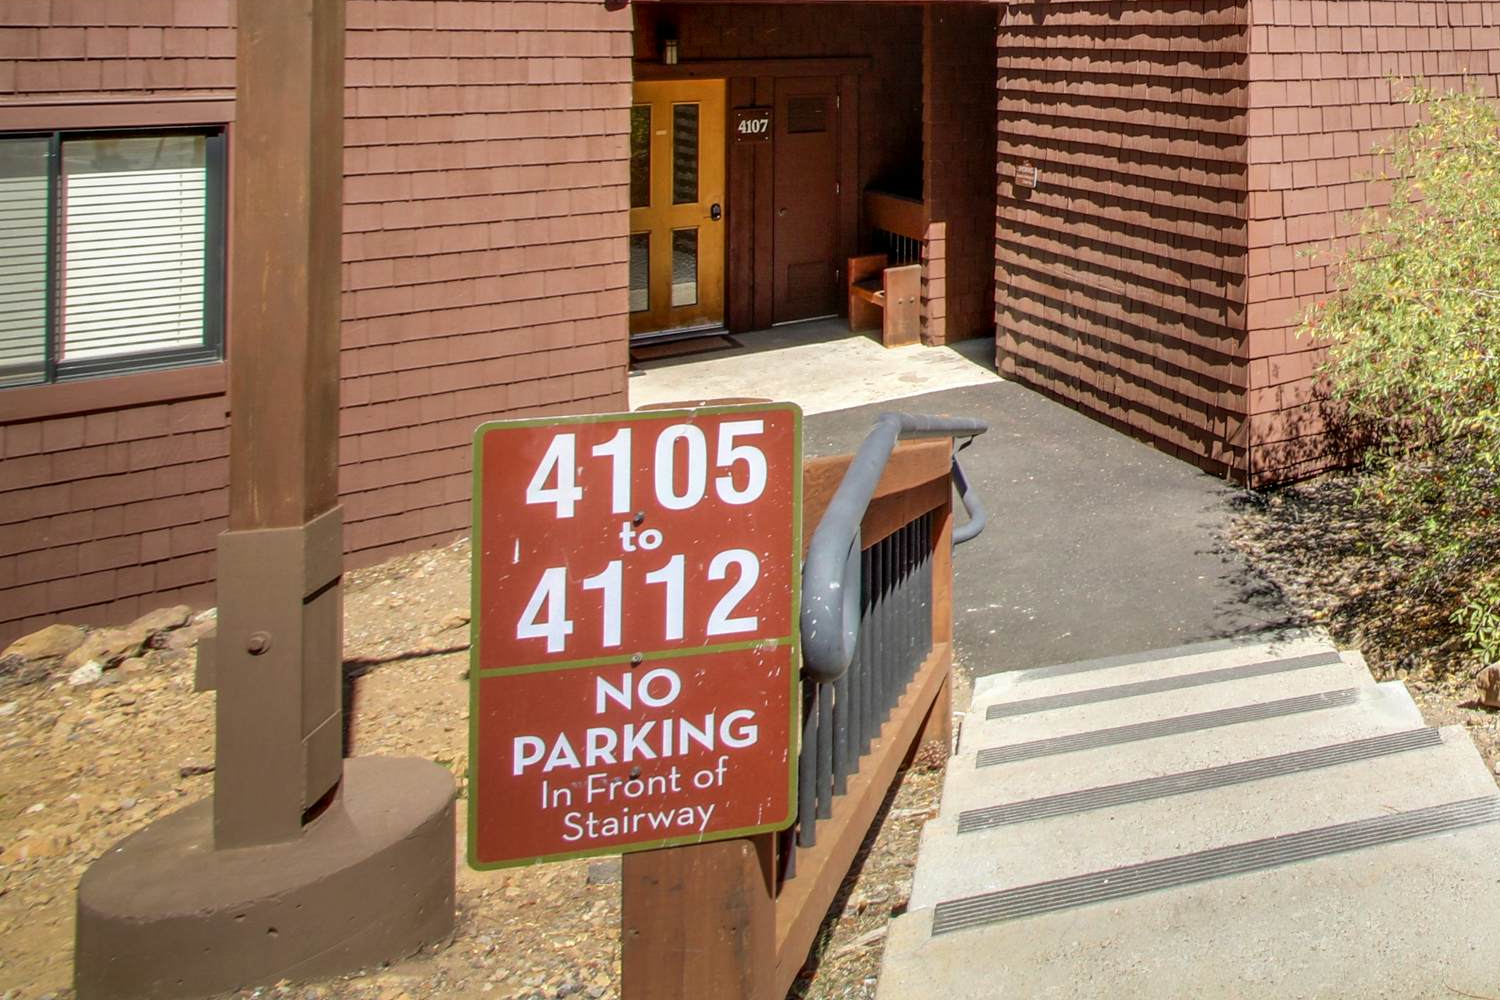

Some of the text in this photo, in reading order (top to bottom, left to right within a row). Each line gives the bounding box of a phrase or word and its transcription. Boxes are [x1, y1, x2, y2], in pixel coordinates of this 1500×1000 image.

[738, 119, 769, 134] 4107
[525, 419, 768, 519] 4105
[619, 521, 664, 552] to
[516, 548, 760, 654] 4112
[595, 667, 682, 714] NO
[512, 709, 758, 776] PARKING
[541, 755, 730, 809] In Front of
[562, 803, 716, 841] Stairway
